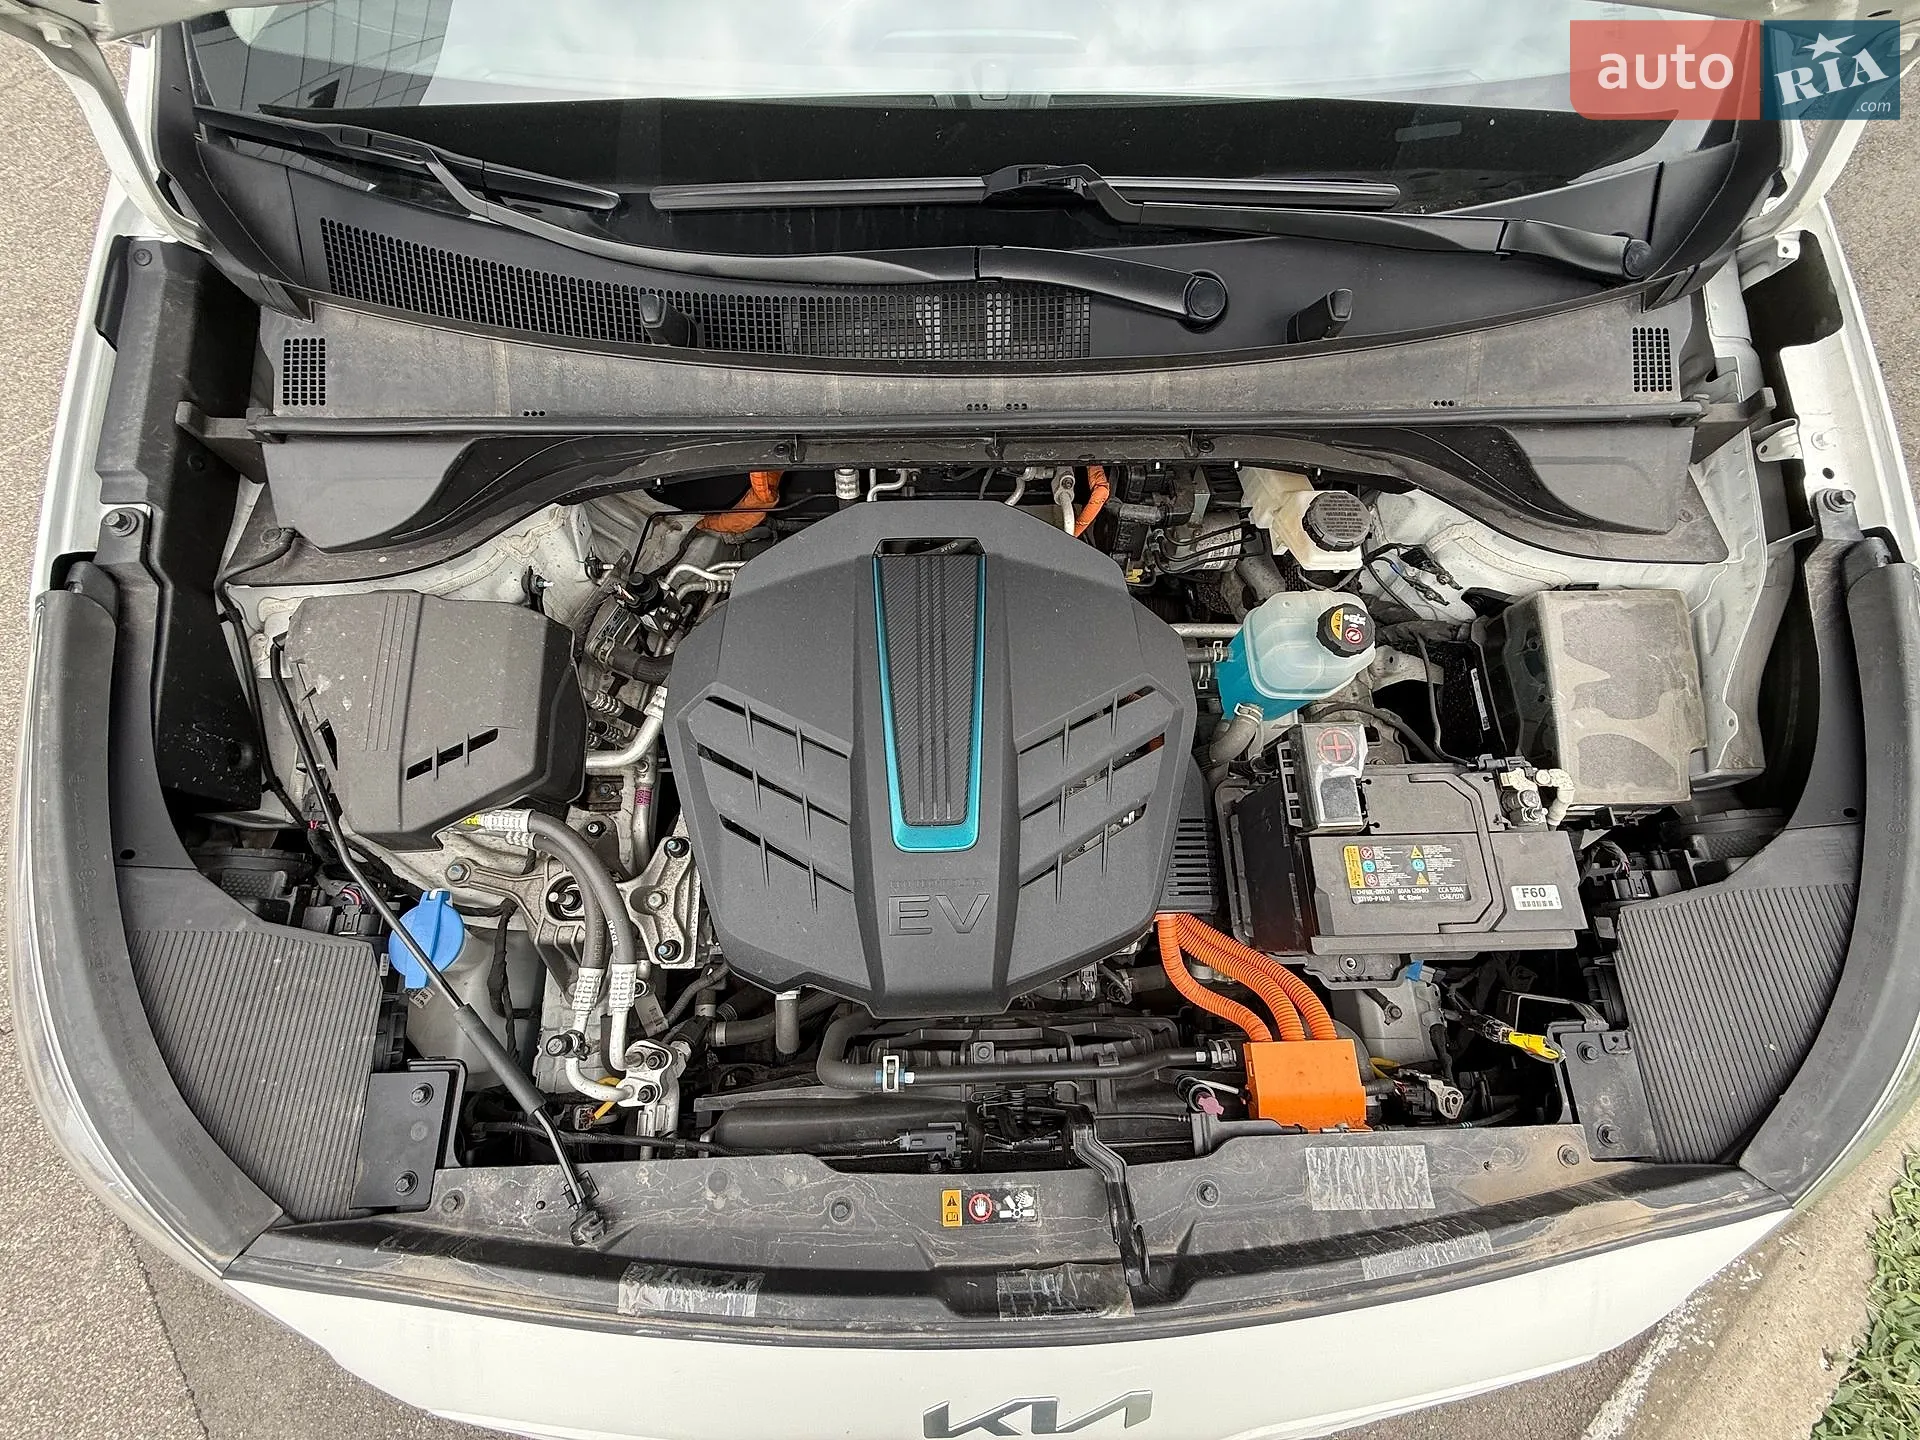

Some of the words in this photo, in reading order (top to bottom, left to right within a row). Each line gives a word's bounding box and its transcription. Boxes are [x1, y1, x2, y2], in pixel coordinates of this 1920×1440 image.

[1521, 887, 1546, 898] F60
[888, 893, 990, 937] EV
[923, 1389, 1153, 1439] KIA
